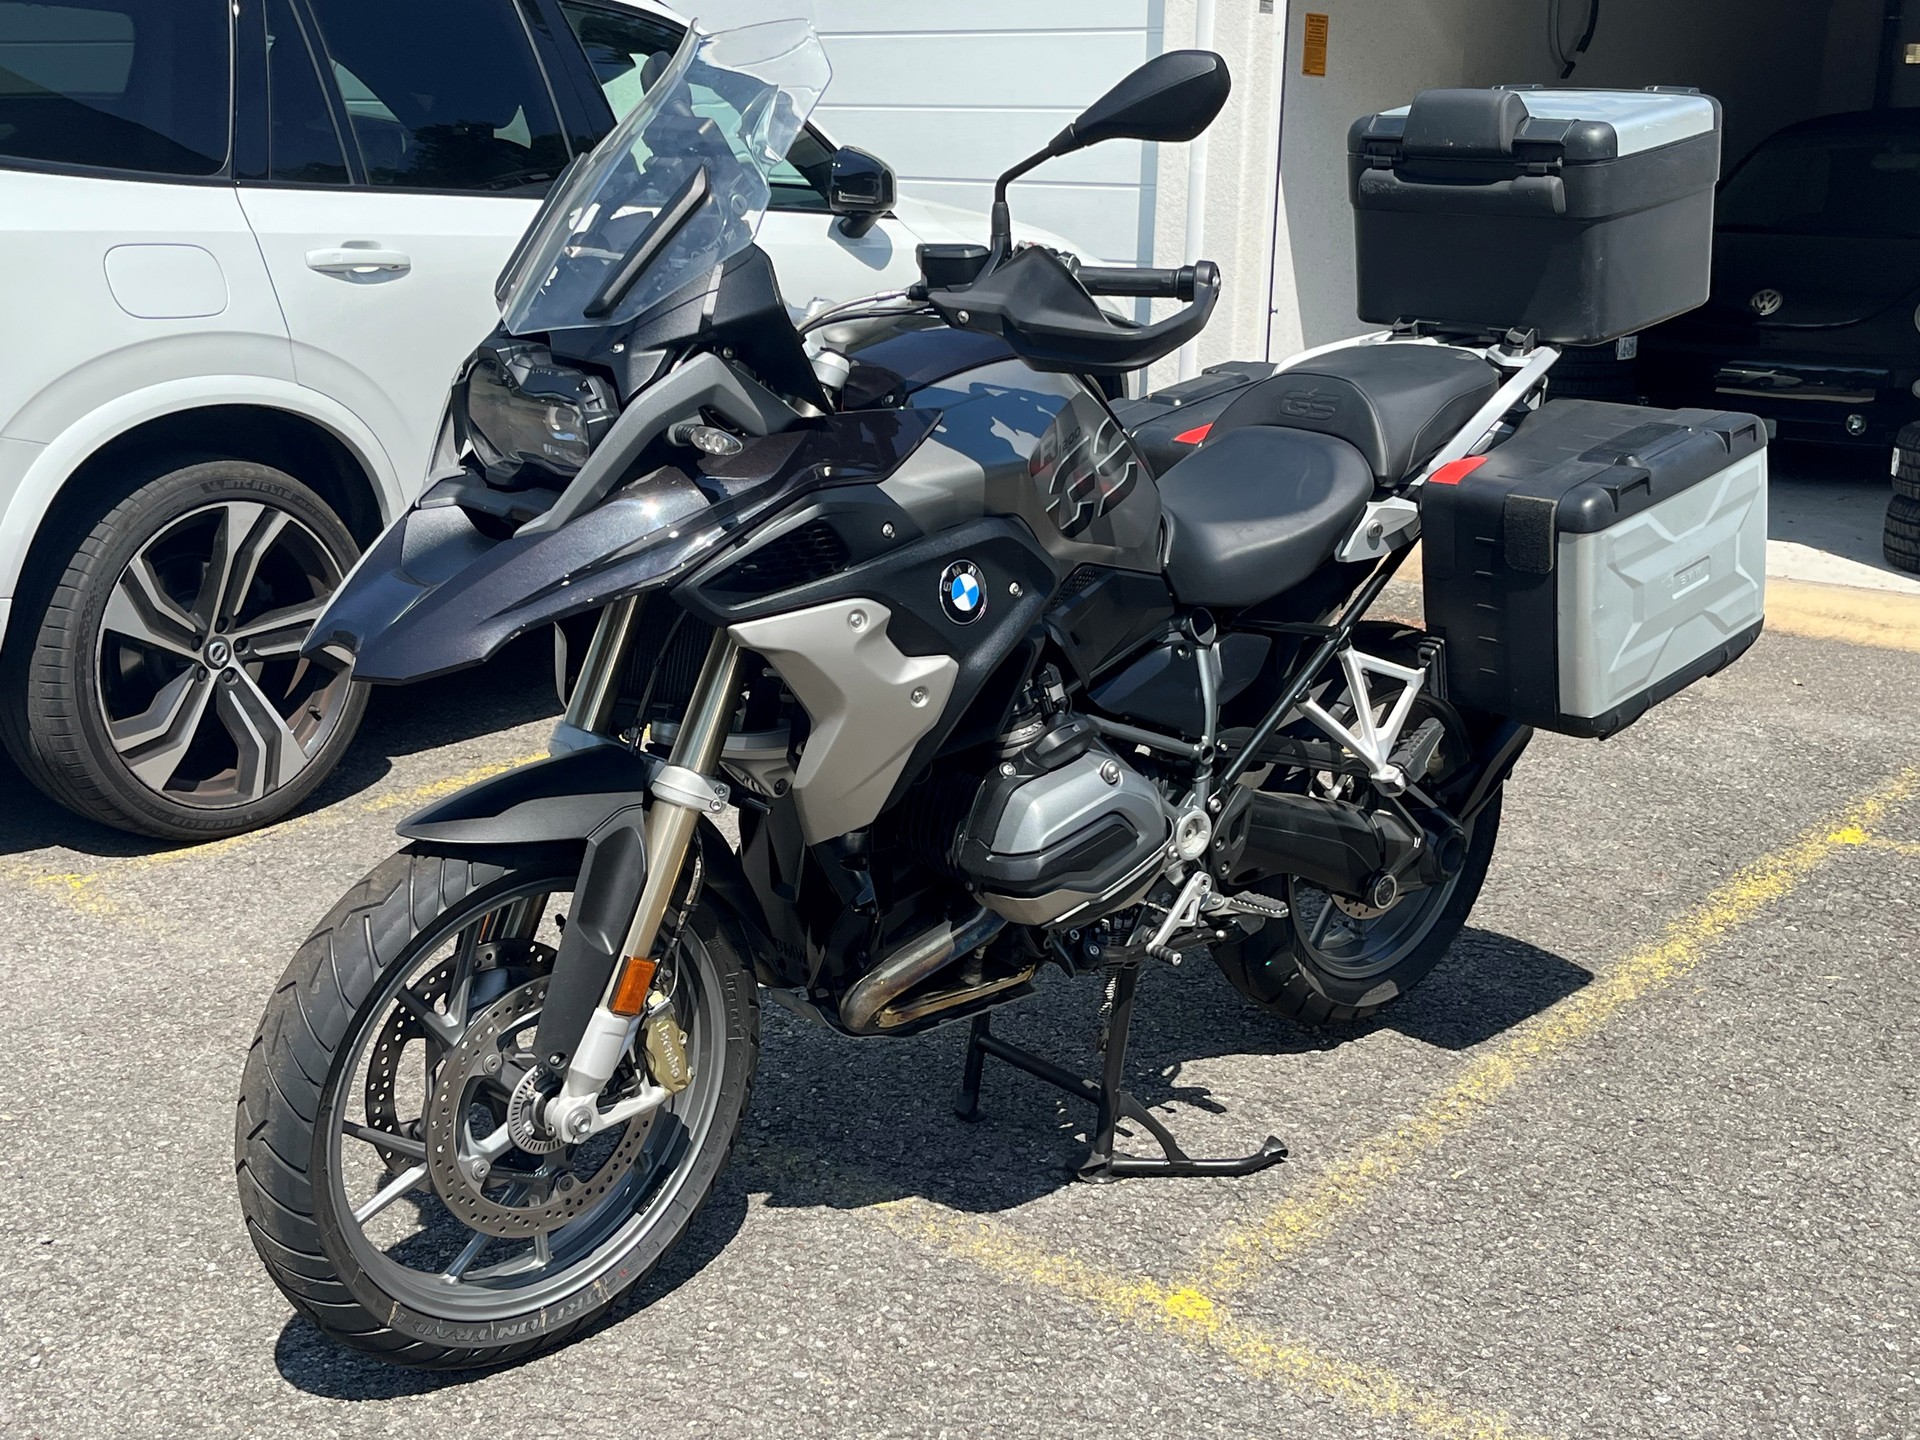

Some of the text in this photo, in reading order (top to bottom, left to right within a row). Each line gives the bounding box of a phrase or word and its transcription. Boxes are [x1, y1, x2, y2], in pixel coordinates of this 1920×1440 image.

[1279, 389, 1343, 420] GS
[1040, 431, 1058, 467] R
[222, 479, 294, 499] MICHELIN
[943, 564, 977, 592] BMW
[657, 1023, 680, 1078] brembo
